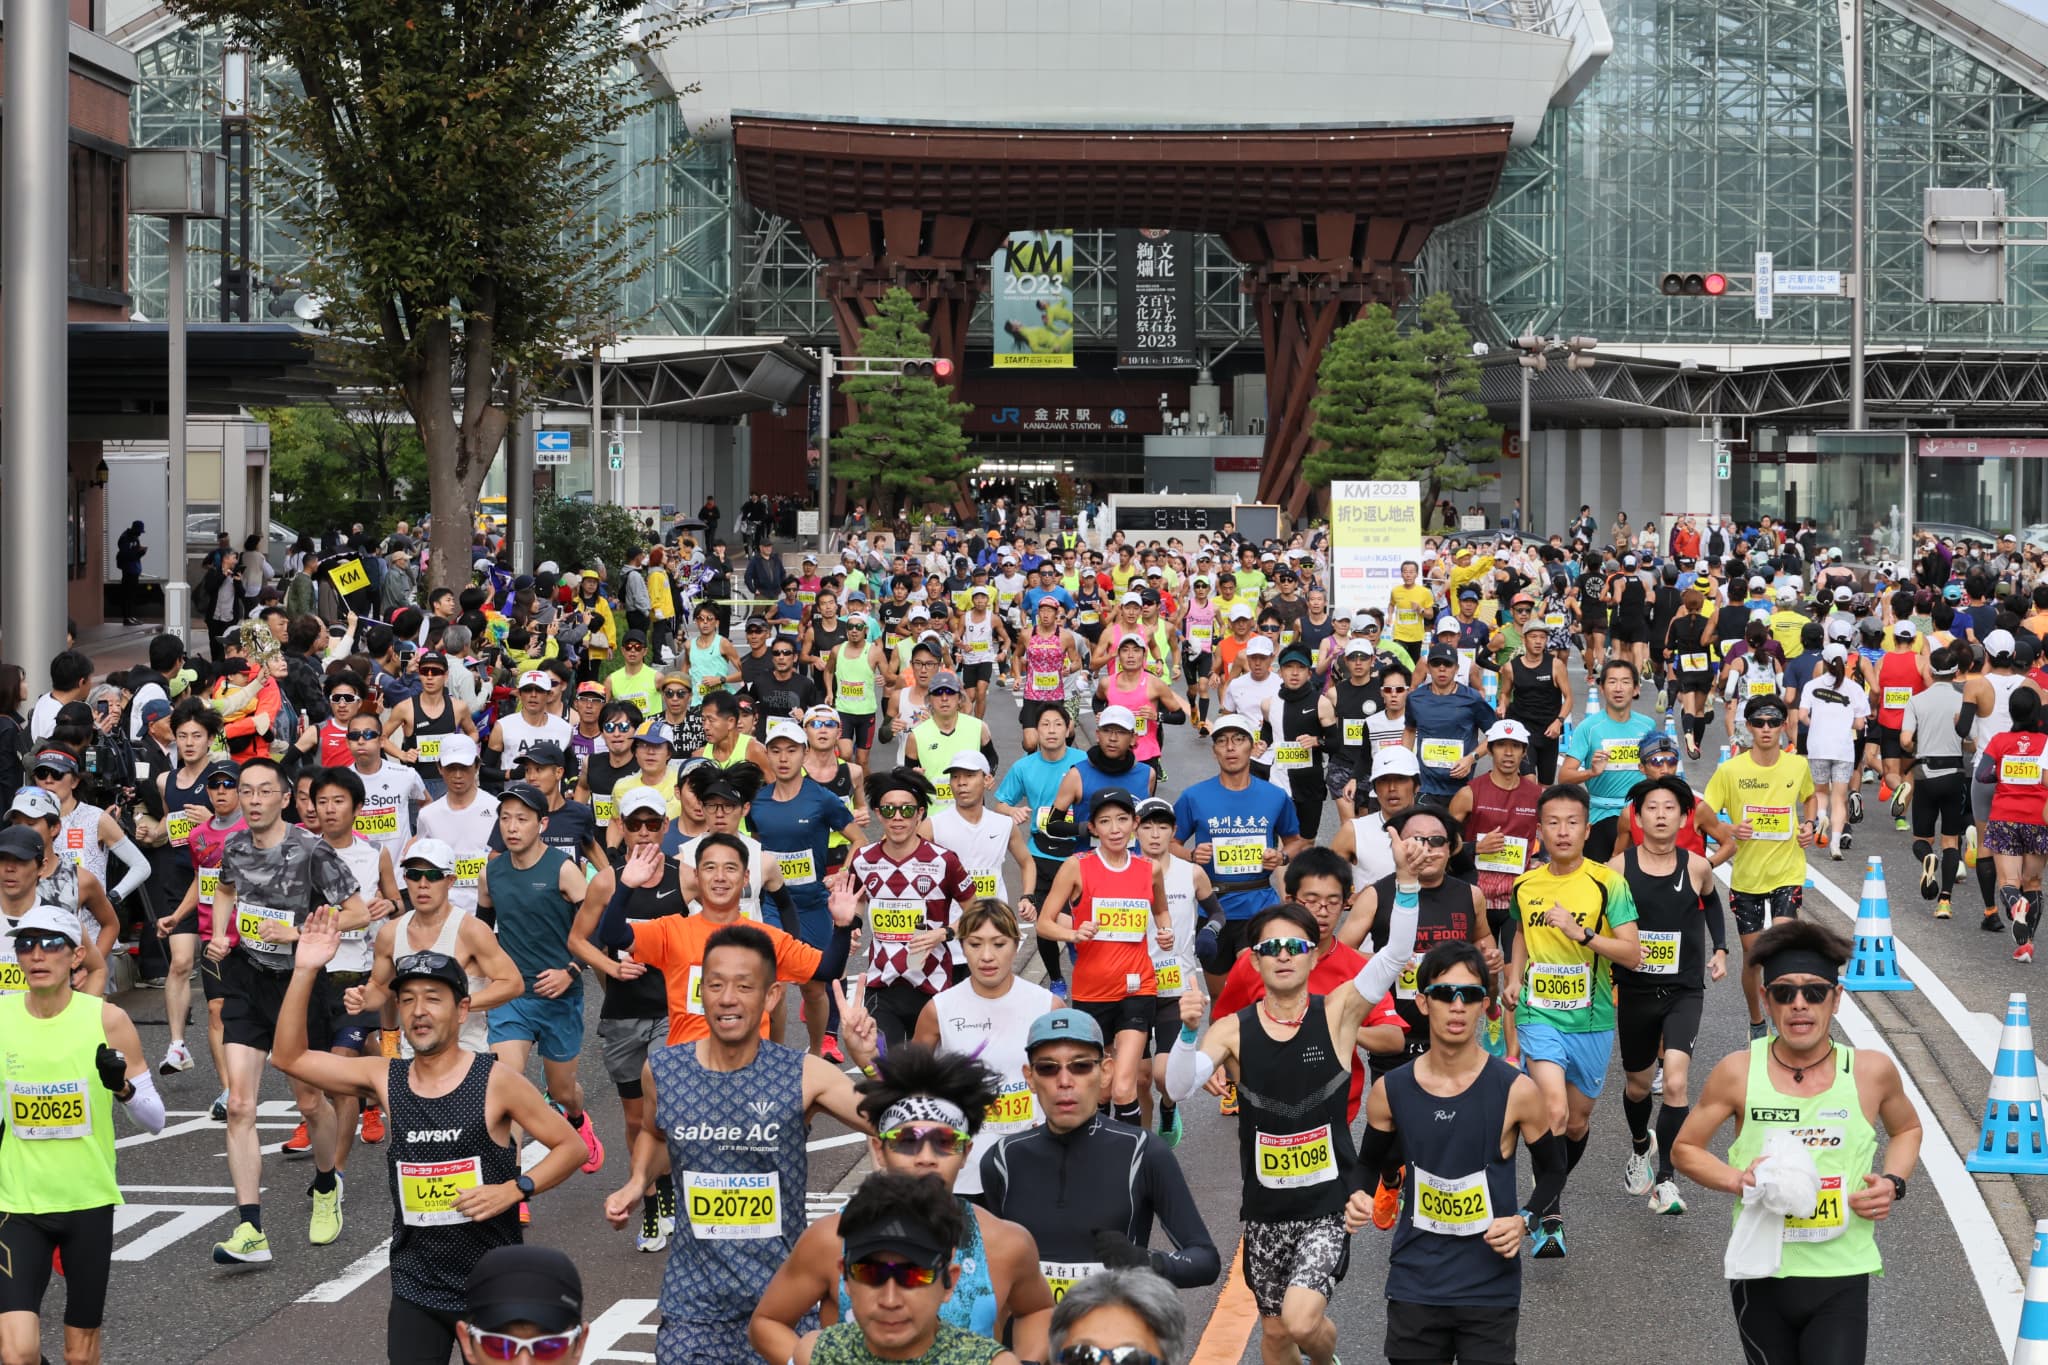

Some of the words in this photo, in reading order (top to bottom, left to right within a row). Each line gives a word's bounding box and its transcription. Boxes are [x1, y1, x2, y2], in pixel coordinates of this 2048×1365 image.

[1004, 241, 1062, 272] KM
[1136, 242, 1153, 277] 絢爛
[1157, 242, 1174, 277] 文化
[1004, 274, 1063, 294] 2023
[1136, 295, 1148, 332] 文化祭
[1150, 295, 1162, 332] 百万石
[1164, 295, 1176, 333] いしかわ
[1137, 335, 1176, 348] 2023
[992, 408, 1020, 423] JR
[1035, 408, 1090, 421] 金沢駅
[1344, 484, 1370, 498] KM
[1373, 484, 1407, 496] 2023
[1338, 505, 1415, 523] 折り返し地点
[339, 566, 363, 588] KM
[1277, 750, 1310, 760] D30963
[2005, 765, 2039, 775] D25171
[356, 818, 395, 831] D31040
[1219, 848, 1263, 862] D31273
[243, 905, 287, 921] AsahiKASEI
[1099, 912, 1147, 927] D25131
[1536, 965, 1583, 974] AsahiKASEI
[1535, 979, 1585, 995] D30615
[14, 1082, 79, 1095] AsahiKASEI
[15, 1100, 83, 1121] D20625
[406, 1129, 462, 1143] SAYSKY
[674, 1122, 742, 1141] sabae
[746, 1123, 780, 1141] AC
[1264, 1145, 1327, 1170] D31098
[694, 1176, 770, 1188] AsahiKASEI
[694, 1196, 773, 1217] D20720
[1422, 1192, 1485, 1217] C30522
